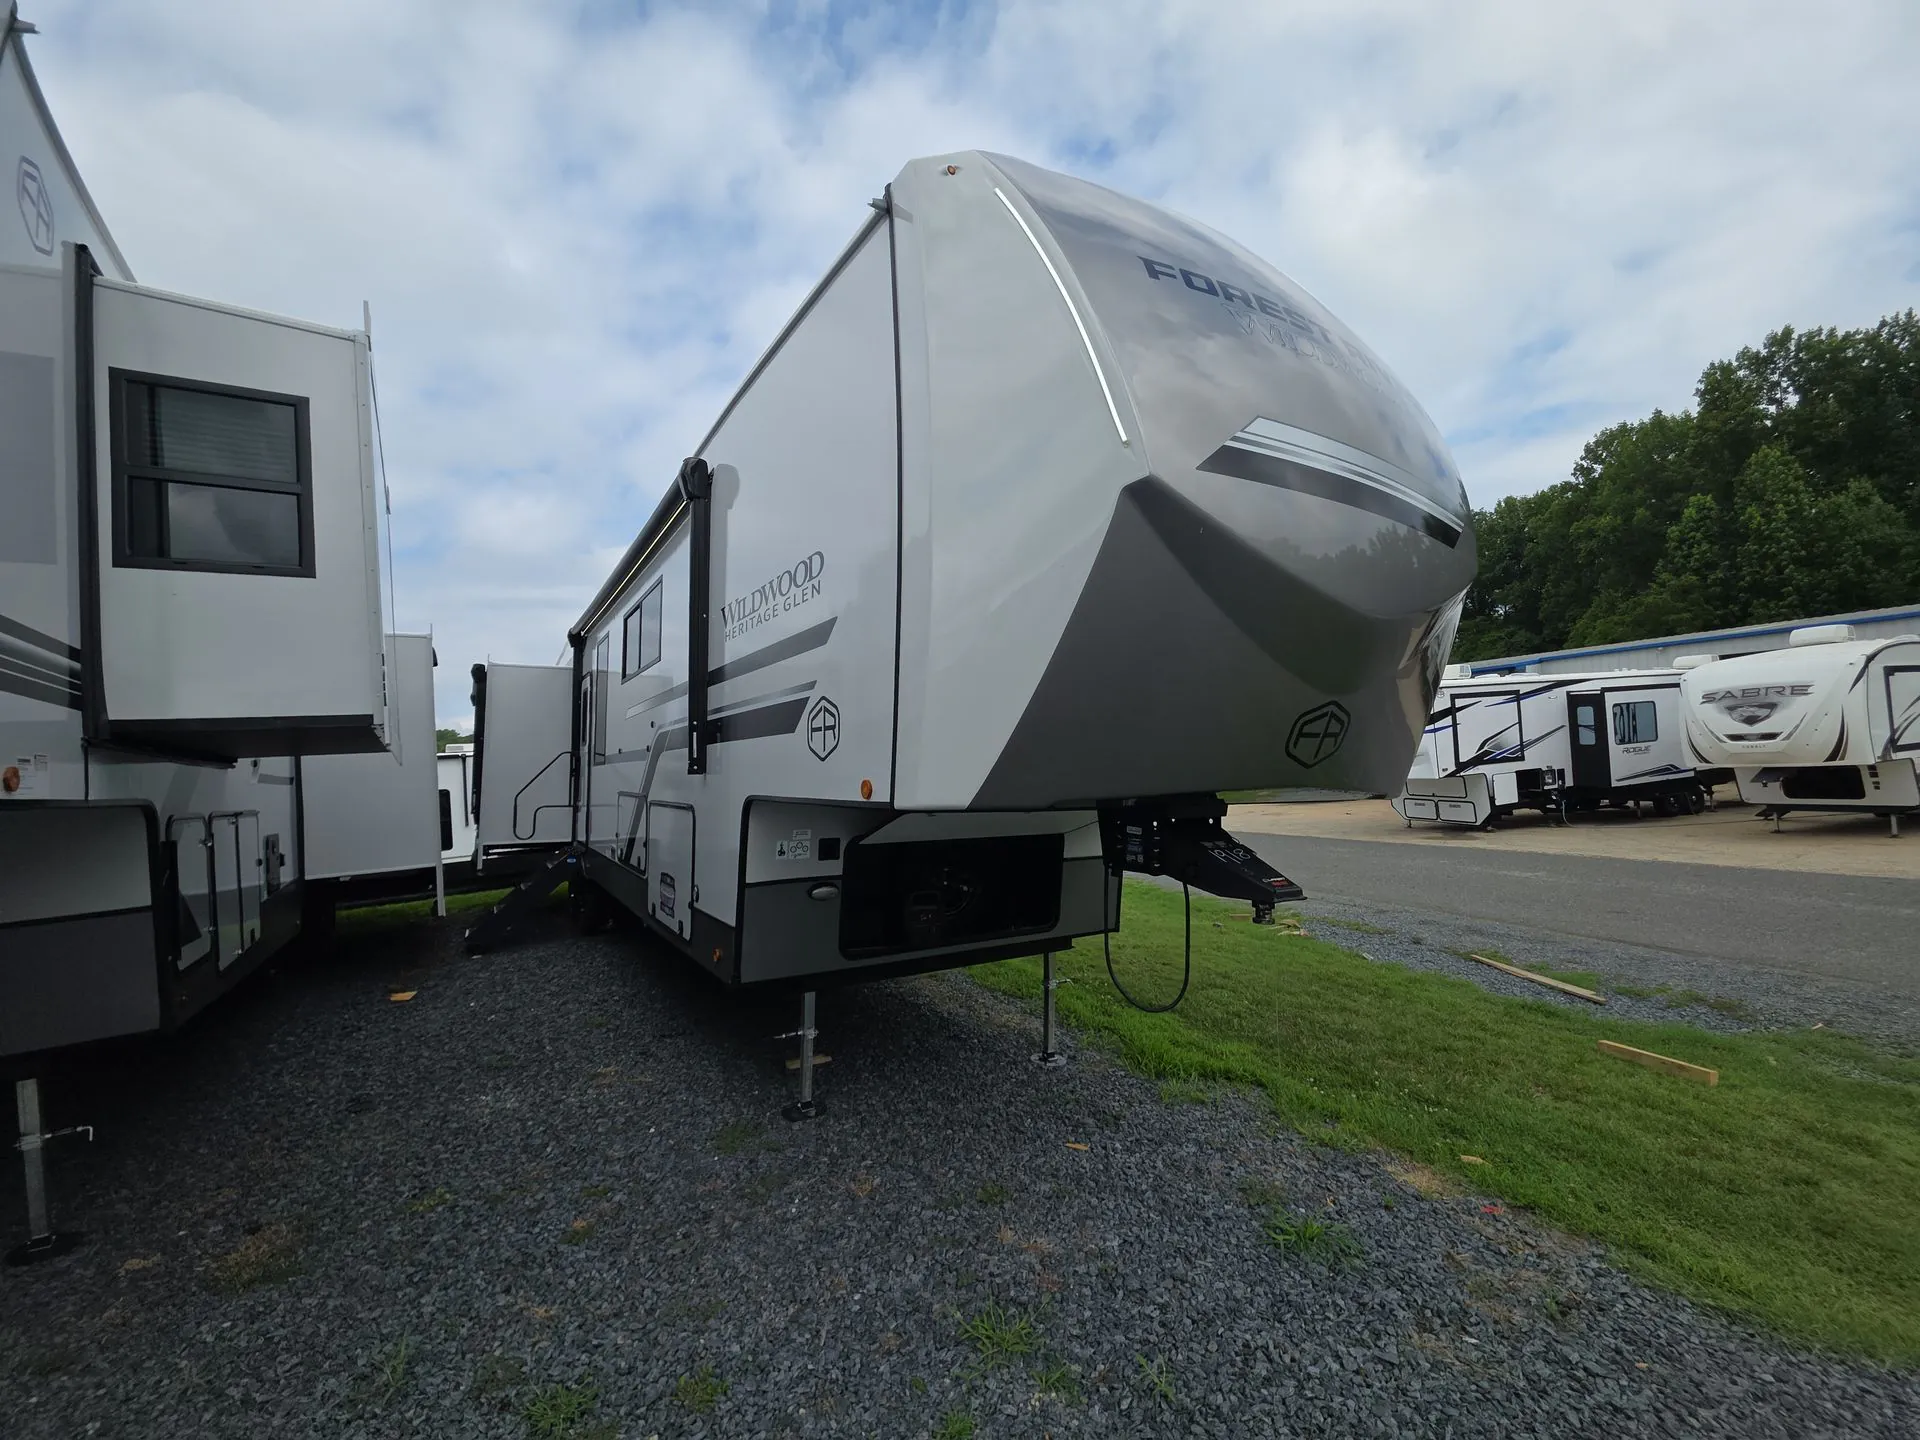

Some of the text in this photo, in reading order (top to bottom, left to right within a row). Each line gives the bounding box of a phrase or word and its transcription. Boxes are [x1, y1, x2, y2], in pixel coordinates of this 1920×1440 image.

[1137, 255, 1333, 345] FOREST
[720, 550, 825, 629] WILDWOOD
[724, 579, 822, 642] HERITAGE GLEN
[1699, 684, 1815, 705] SABRE
[1622, 745, 1651, 754] ROGUE
